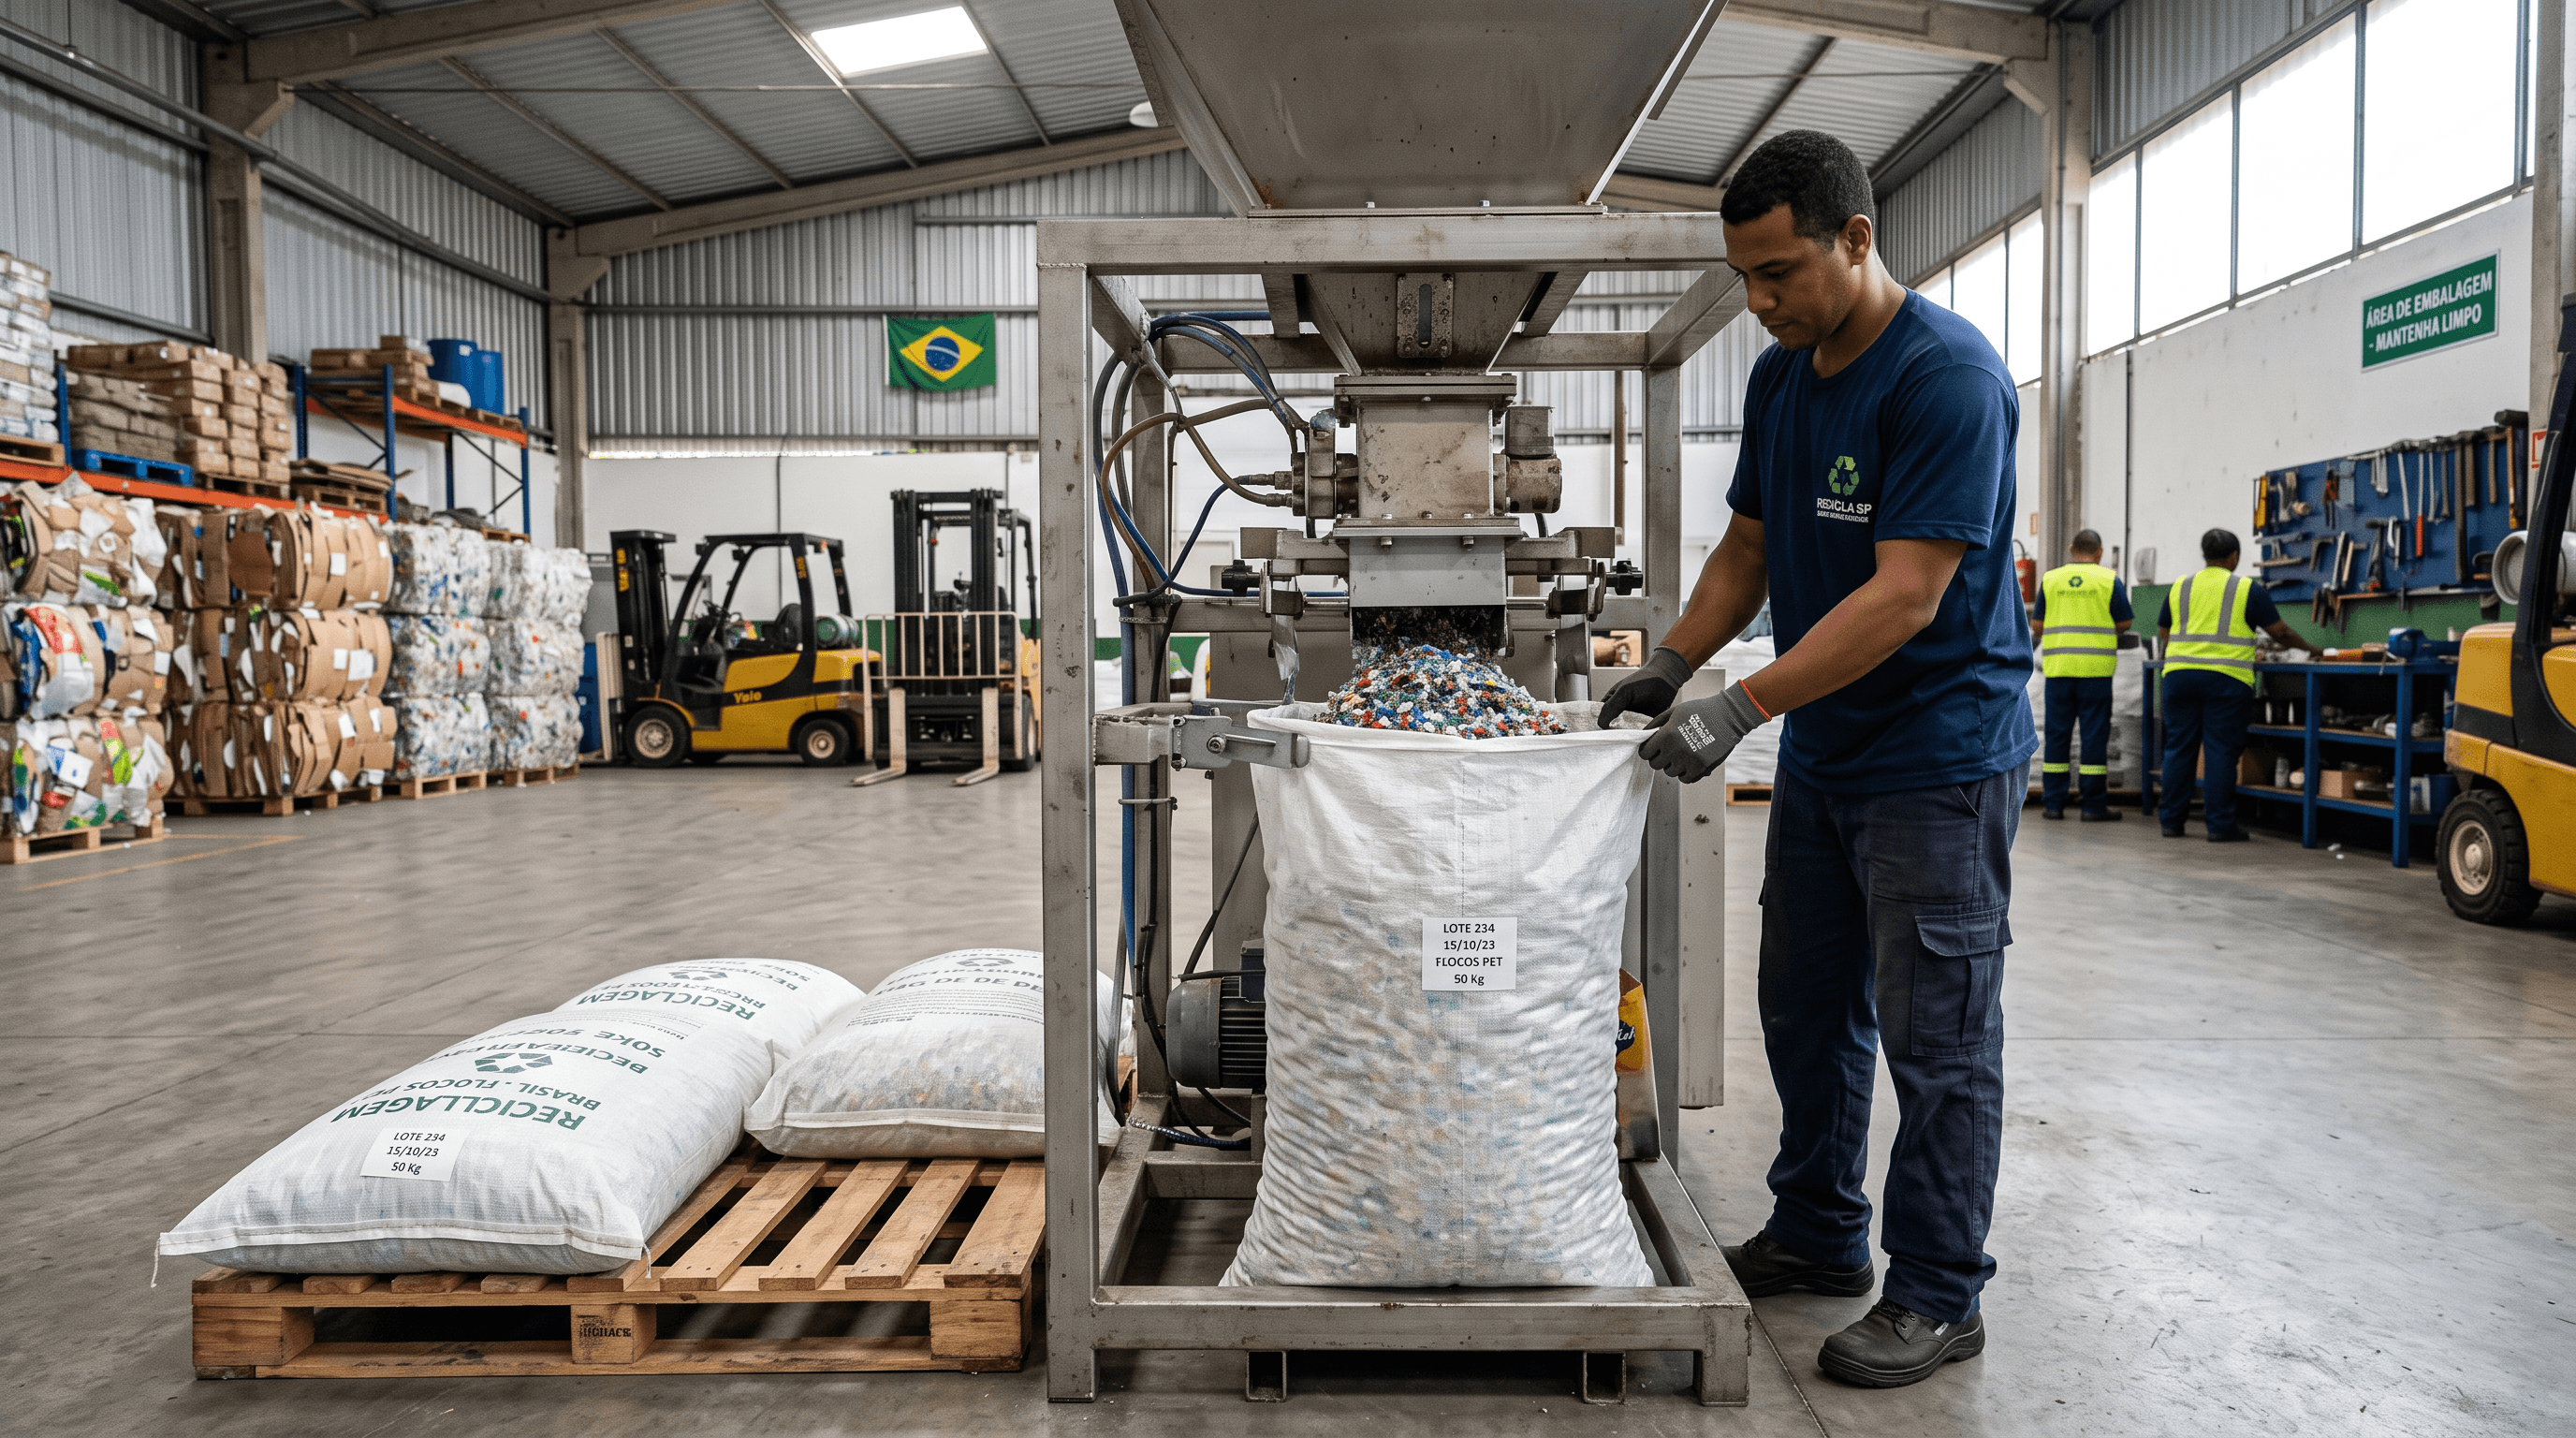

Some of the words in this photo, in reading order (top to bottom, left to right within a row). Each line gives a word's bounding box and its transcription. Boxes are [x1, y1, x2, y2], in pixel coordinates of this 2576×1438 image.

[2365, 303, 2394, 330] ÁREA
[2396, 297, 2412, 320] DE
[2414, 270, 2493, 315] EMBALAGEM
[2375, 315, 2439, 353] MANTENHA
[2442, 302, 2482, 333] LIMPO
[1855, 503, 1872, 515] SP
[1443, 923, 1471, 933] LOTE
[1474, 923, 1495, 933] 234
[1443, 939, 1495, 951] 15/10/23
[1436, 957, 1479, 967] FLOCOS
[1483, 957, 1503, 967] PET
[1454, 974, 1468, 984] 50
[1471, 974, 1485, 987] Kg
[577, 990, 755, 1020] RECICLAGEM
[403, 1078, 500, 1092] FLOCOS
[519, 1082, 602, 1111] BRASIL
[330, 1095, 586, 1131] RECICLLAGEM
[393, 1132, 423, 1141] LOTE
[424, 1133, 446, 1141] 234
[387, 1145, 439, 1158] 15/10/23
[391, 1161, 405, 1172] 50
[407, 1163, 421, 1176] Kg
